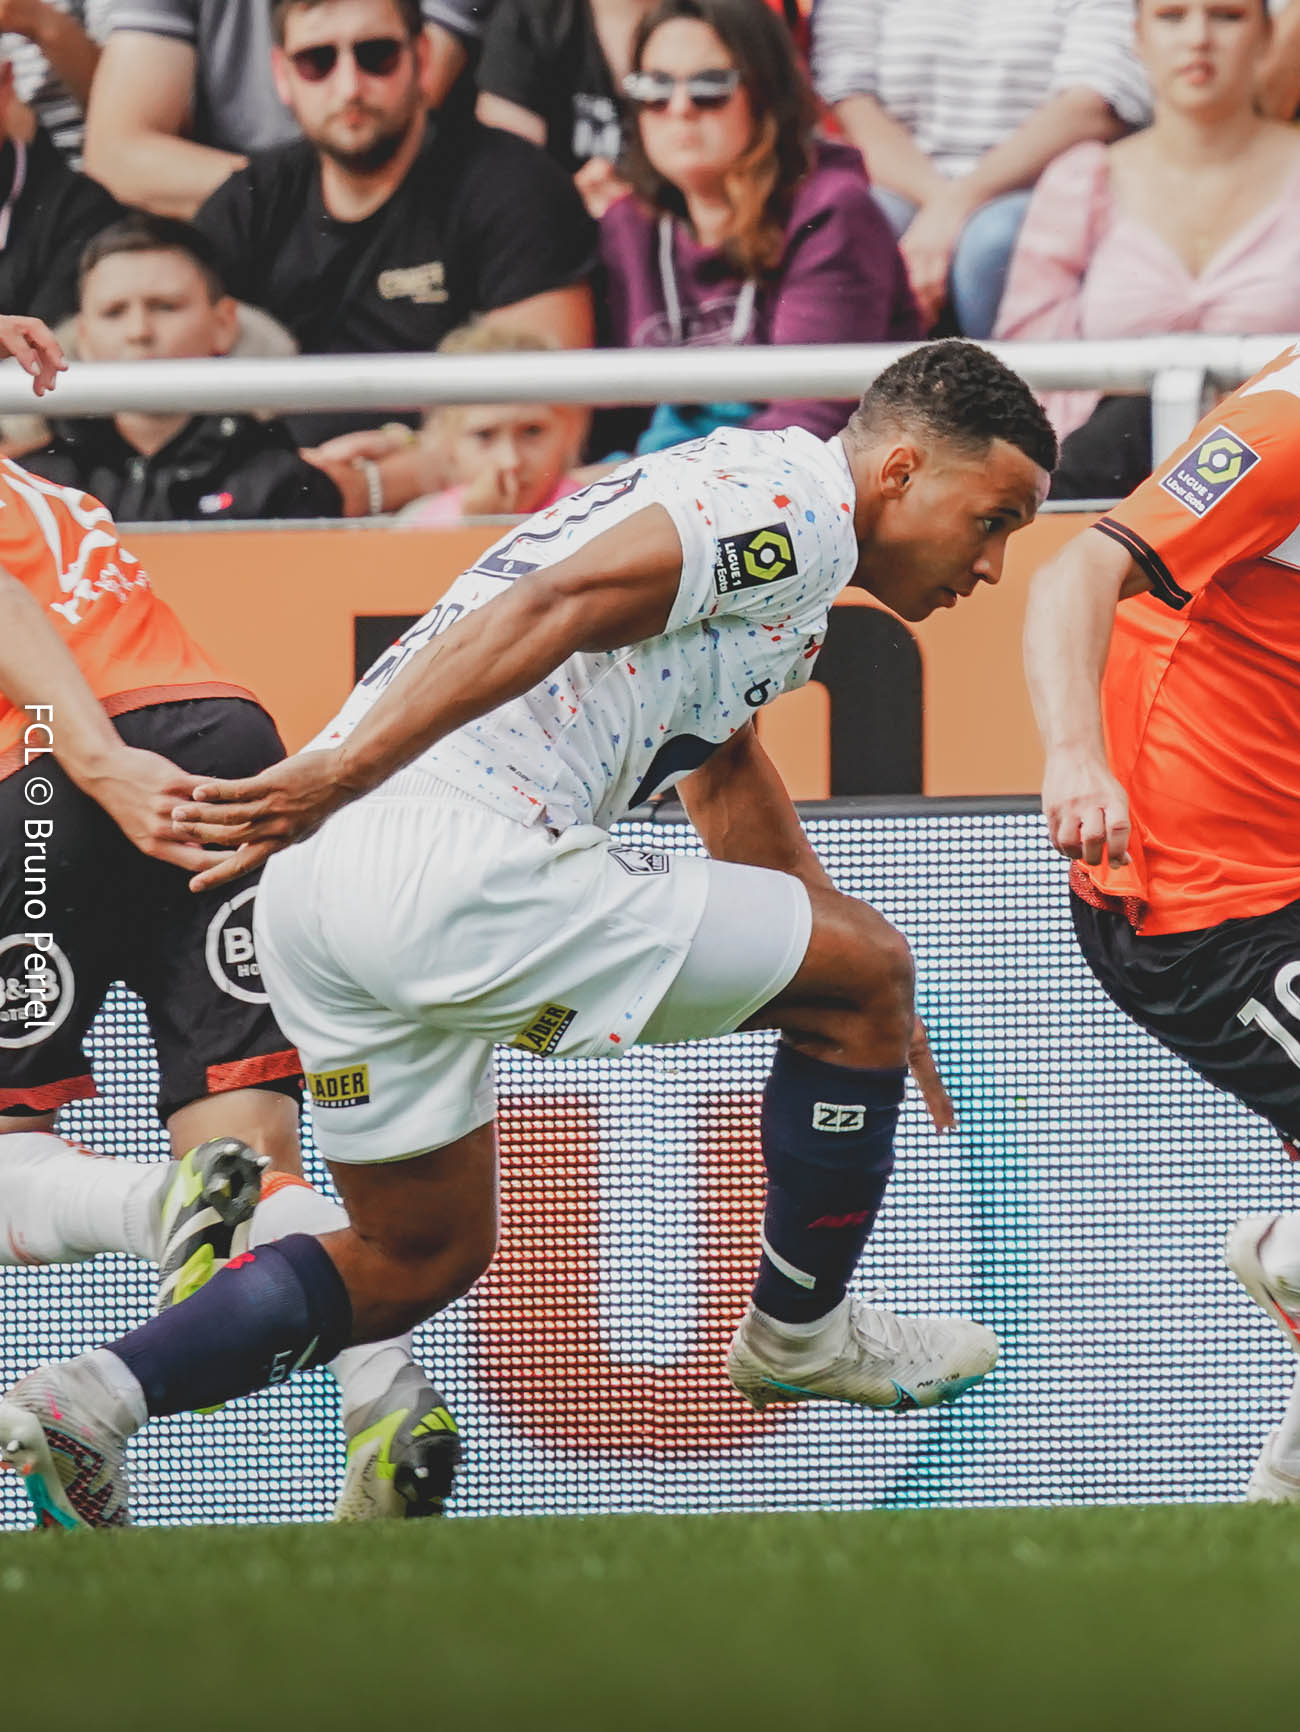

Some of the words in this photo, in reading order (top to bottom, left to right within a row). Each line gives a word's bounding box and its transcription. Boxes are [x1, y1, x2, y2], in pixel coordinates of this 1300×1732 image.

[1166, 477, 1187, 496] Uber
[1184, 491, 1206, 512] Eats
[1177, 470, 1208, 497] LIGUE
[1205, 492, 1214, 501] 1
[724, 542, 741, 579] LIGUE
[717, 567, 729, 592] Eats
[0, 967, 60, 1008] &B
